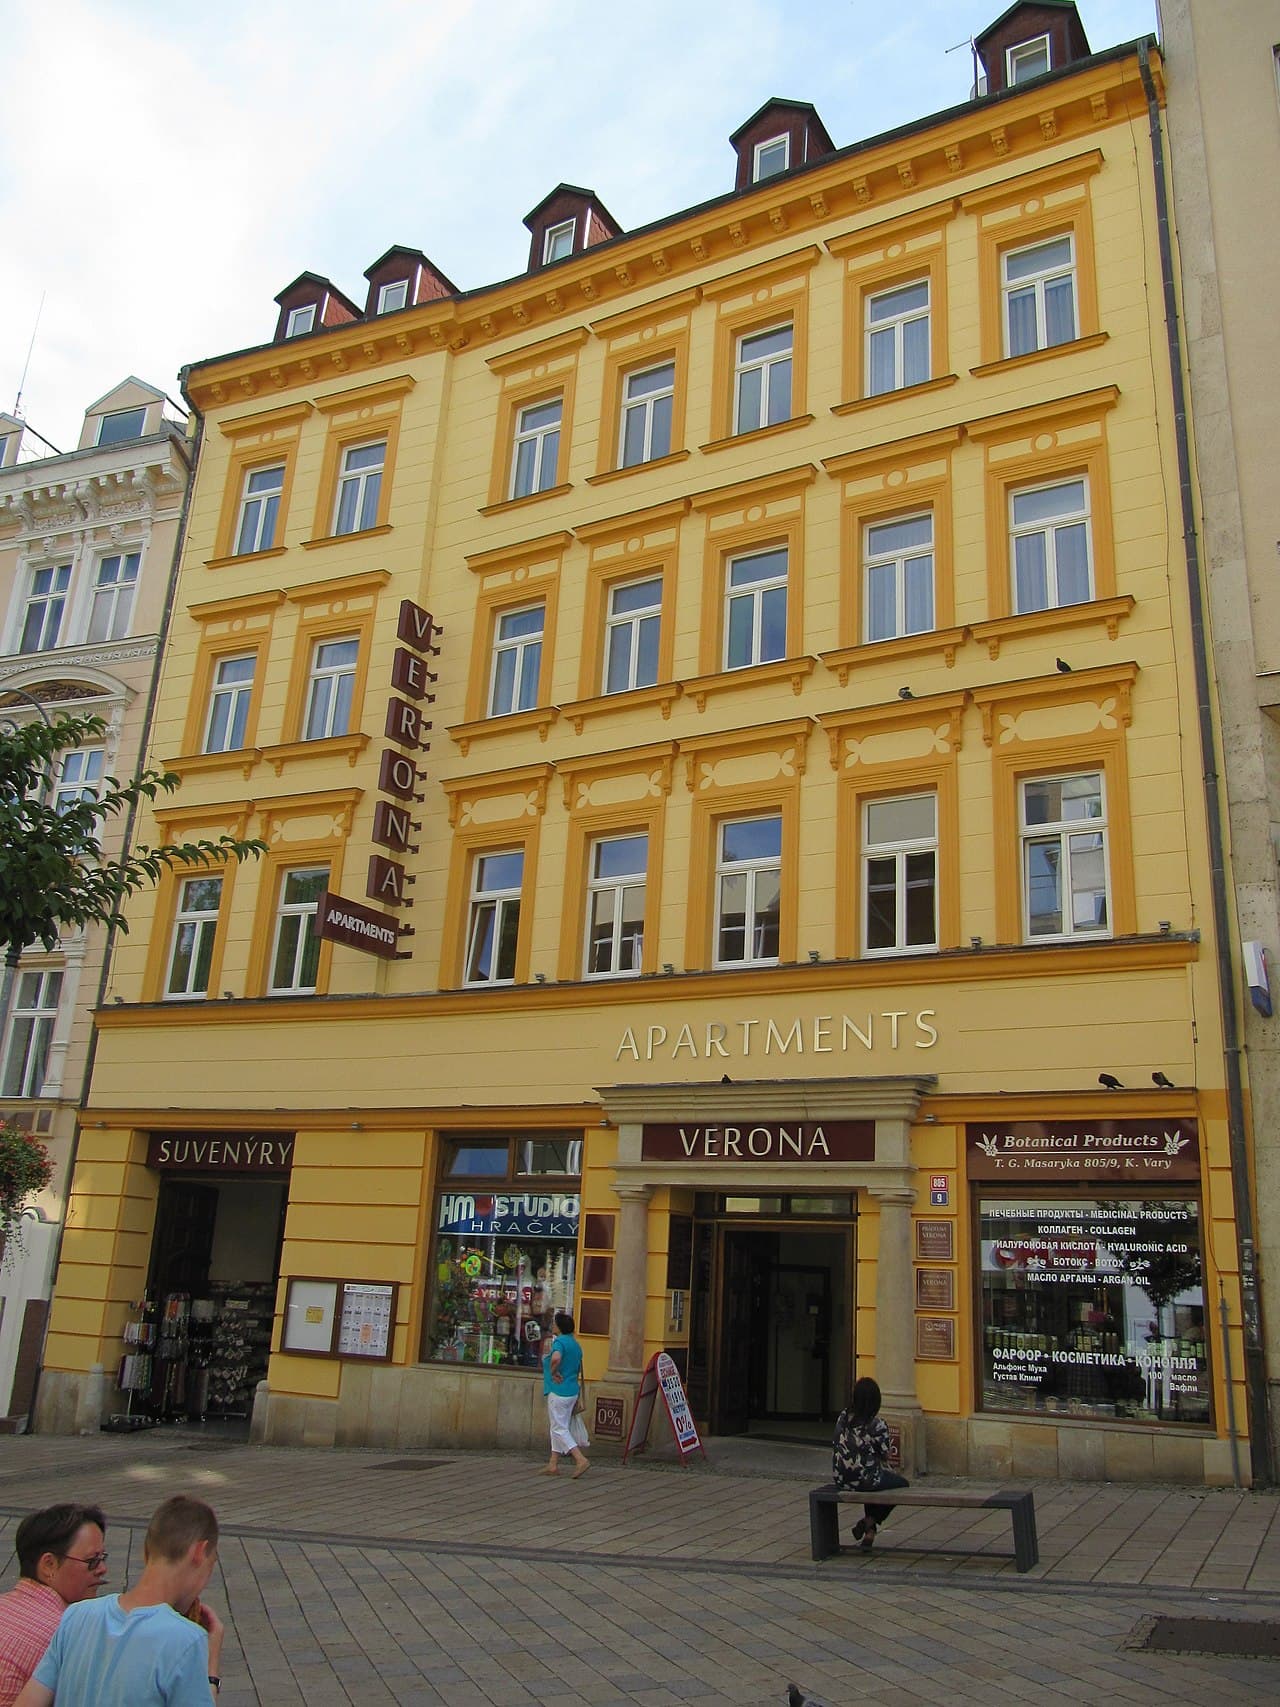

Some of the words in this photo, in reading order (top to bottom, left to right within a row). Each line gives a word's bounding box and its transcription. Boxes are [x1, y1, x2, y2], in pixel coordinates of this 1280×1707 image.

[381, 607, 430, 898] VERONA
[327, 908, 396, 946] APARTMENTS
[615, 1009, 938, 1061] APARTMENTS
[679, 1126, 831, 1156] VERONA
[1003, 1134, 1078, 1149] Botanical
[1082, 1133, 1159, 1148] Products
[158, 1135, 293, 1165] SUVENÝRY
[994, 1158, 1005, 1168] T.
[1008, 1158, 1021, 1168] G.
[1024, 1158, 1080, 1170] Masaryka
[1083, 1158, 1121, 1169] 805/9,
[1124, 1158, 1139, 1168] K.
[1143, 1158, 1172, 1170] Vary
[936, 1193, 943, 1203] 9
[439, 1195, 476, 1229] HM
[496, 1196, 580, 1218] STUDIO
[989, 1208, 1035, 1218] ЛЕЧЕБНЫЕ
[1036, 1209, 1084, 1220] ПРОДУКТЫ
[1090, 1210, 1138, 1220] MEDICINAL
[1140, 1210, 1188, 1220] PRODUCTS
[471, 1220, 580, 1234] HRAČKY
[1037, 1225, 1083, 1235] КОЛЛАГЕН
[1089, 1226, 1136, 1236] COLLAGEN
[991, 1239, 1058, 1251] ГИАЛУРОНОВАЯ
[1060, 1240, 1101, 1251] КИСЛОТА
[1107, 1243, 1164, 1253] HYALURONIC
[1166, 1244, 1188, 1253] ACID
[1053, 1257, 1088, 1267] БОТОКС
[1027, 1272, 1058, 1282] МАСЛО
[1059, 1273, 1096, 1283] АРГАНЫ
[1102, 1274, 1133, 1284] ARGAN
[1135, 1276, 1151, 1286] OIL
[992, 1347, 1042, 1362] ФАРФОР
[1052, 1350, 1126, 1367] КОСМЕТИКА
[1135, 1356, 1197, 1370] КОНОПЛЯ
[992, 1362, 1027, 1373] Альфонс
[1028, 1363, 1047, 1374] Муха
[992, 1371, 1018, 1382] Густав
[1018, 1372, 1043, 1383] Климт
[1171, 1373, 1197, 1383] масло
[1169, 1382, 1198, 1393] Вафли
[598, 1408, 621, 1426] 0%
[675, 1415, 692, 1433] 0%
